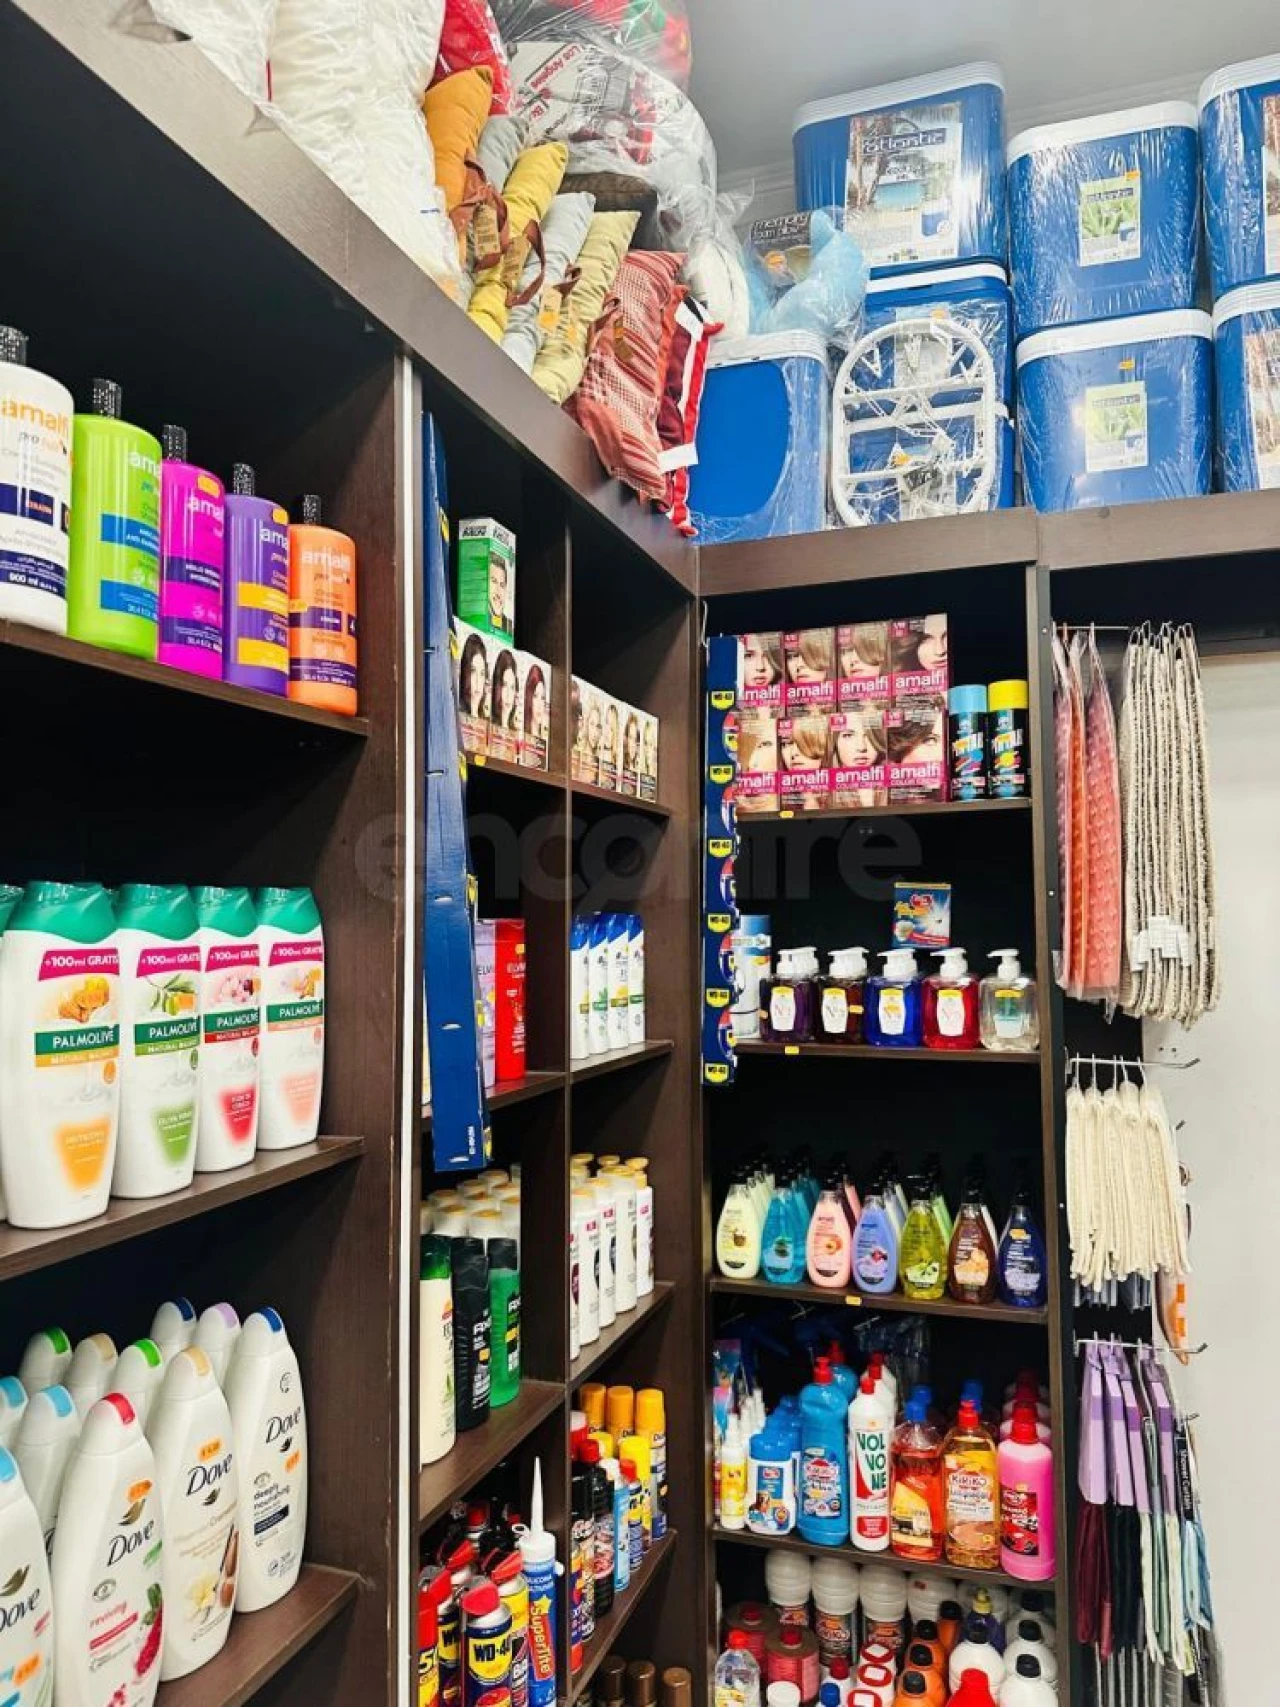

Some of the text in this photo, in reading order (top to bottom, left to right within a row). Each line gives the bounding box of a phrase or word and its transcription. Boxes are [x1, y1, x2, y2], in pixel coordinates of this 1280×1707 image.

[841, 675, 888, 693] amalfi
[895, 669, 944, 688] amalfi
[745, 684, 781, 700] malfi
[787, 681, 834, 698] amalfi
[781, 769, 829, 787] amalfi
[836, 766, 883, 783] amalfi
[890, 761, 939, 779] amalfi
[738, 772, 775, 788] malfi
[216, 1010, 259, 1027] PALMOLIVE
[279, 1003, 321, 1019] PALMOLIVE
[149, 1022, 198, 1039] PALMOLIVE
[52, 1031, 115, 1049] PALMOLIVE
[265, 1406, 301, 1444] Dove
[856, 1431, 885, 1451] VOL
[865, 1453, 885, 1471] VO
[186, 1453, 233, 1497] Dove
[871, 1471, 887, 1491] NE
[107, 1519, 154, 1567] Dove
